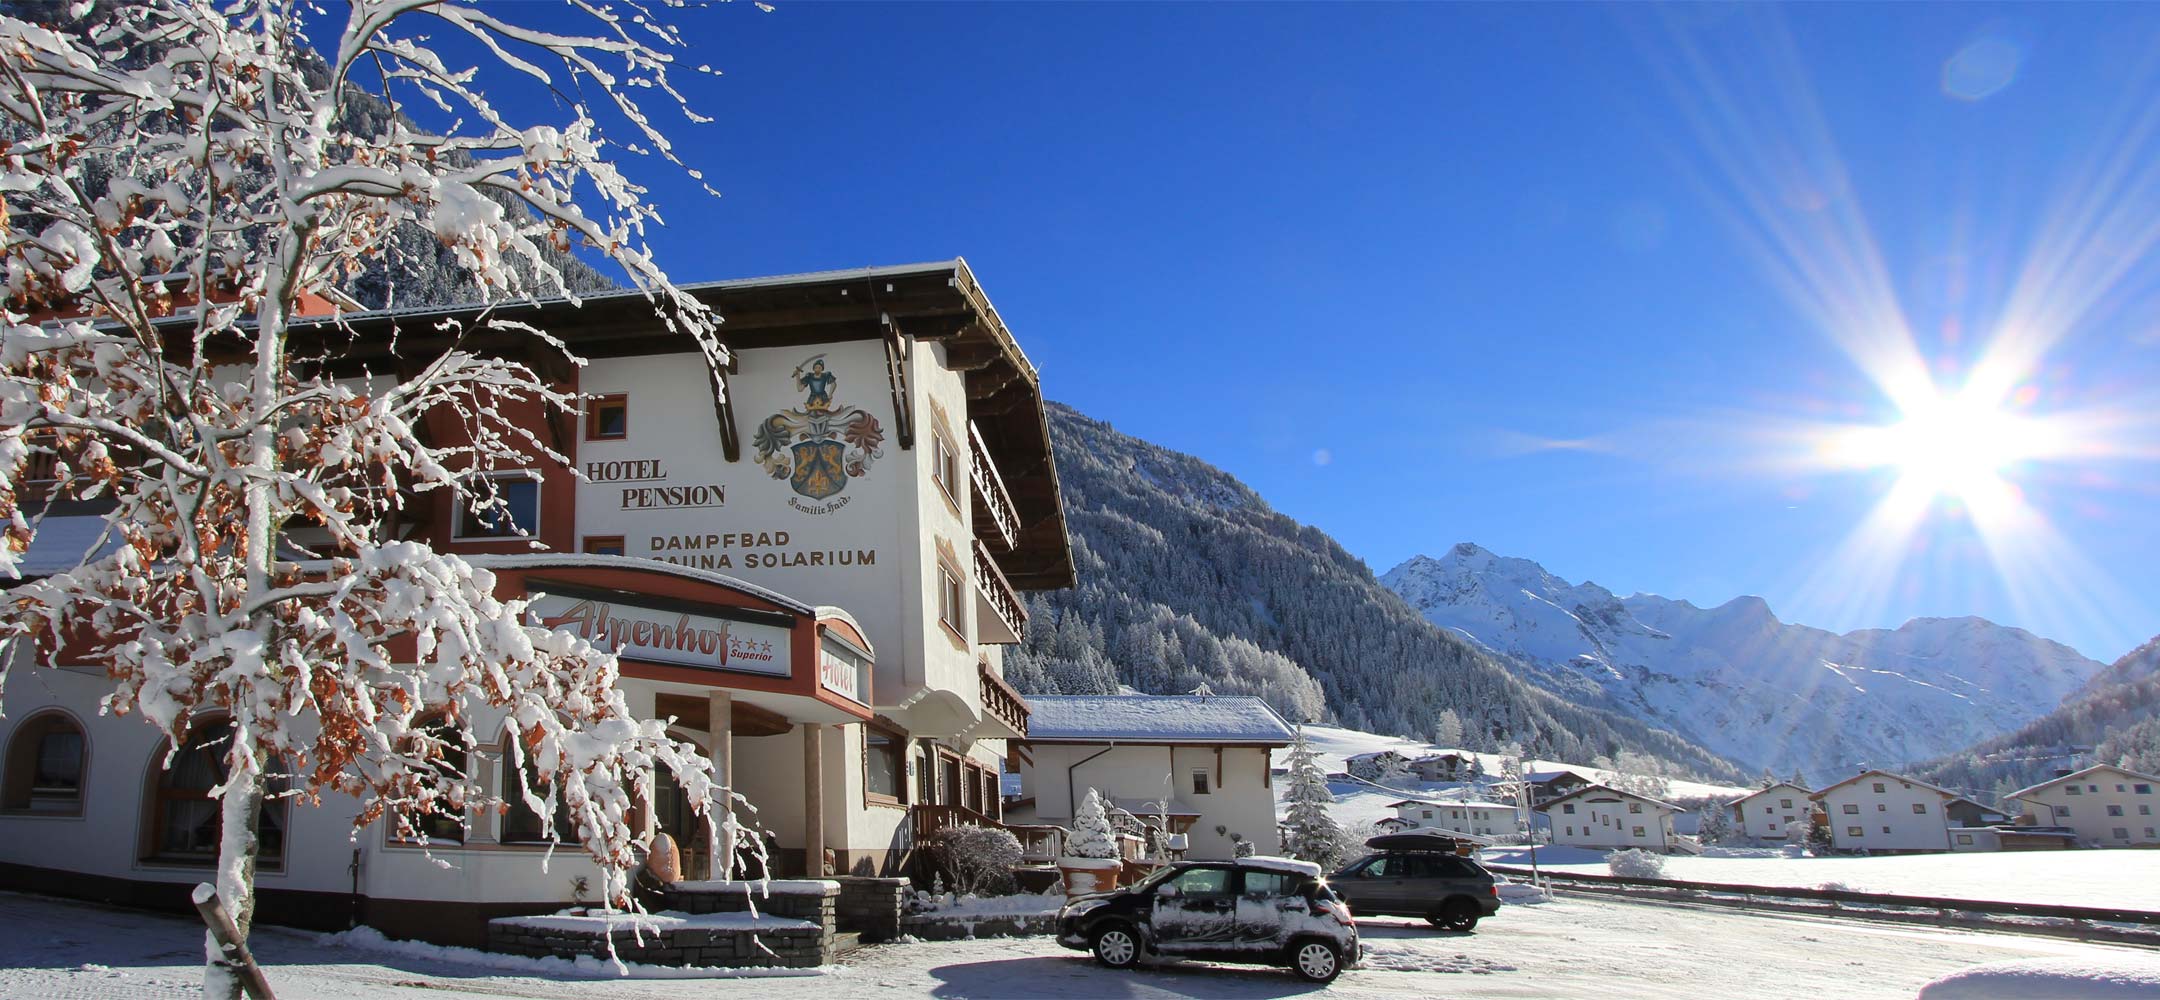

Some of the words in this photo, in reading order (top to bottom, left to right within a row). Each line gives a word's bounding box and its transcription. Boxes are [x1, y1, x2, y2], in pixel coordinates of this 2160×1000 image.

[586, 459, 667, 481] HOTEL
[622, 485, 725, 508] PENSION
[651, 531, 790, 551] DAMPFBAD
[744, 549, 875, 569] SOLARIUM
[543, 600, 731, 666] Alpenhof
[730, 649, 773, 661] Superior
[823, 653, 853, 693] Hotel
